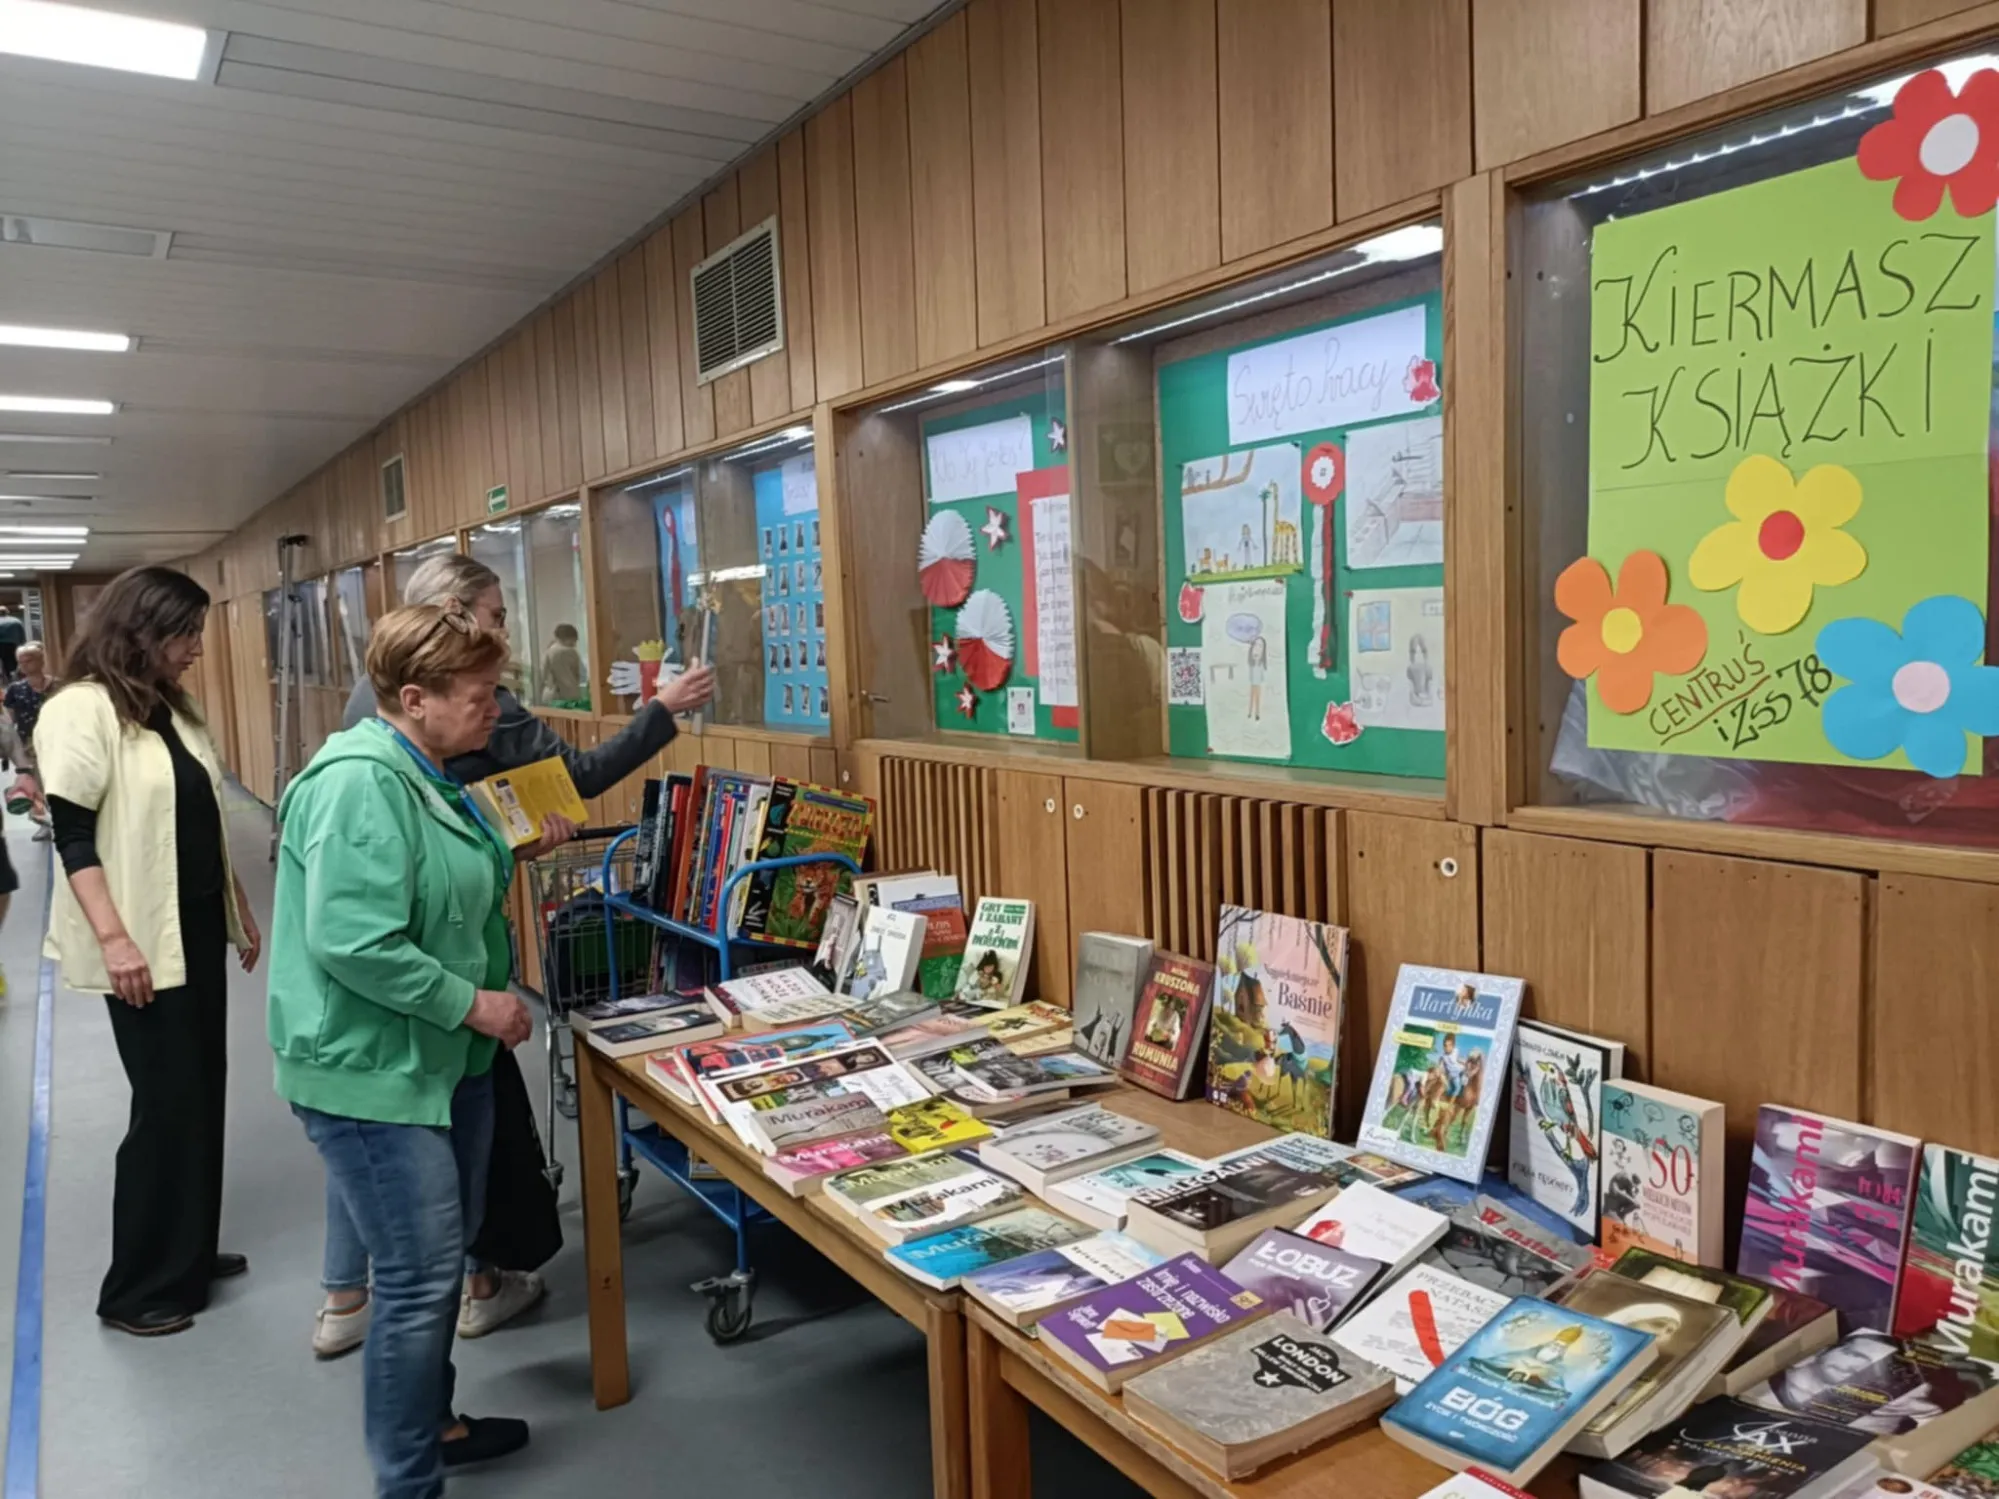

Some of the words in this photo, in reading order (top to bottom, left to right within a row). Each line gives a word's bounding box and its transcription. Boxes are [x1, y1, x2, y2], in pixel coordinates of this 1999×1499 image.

[1621, 328, 1936, 469] KSIĄŻKI
[1649, 629, 1766, 736] CENTRUŚ
[1775, 653, 1832, 708] 78
[1278, 981, 1333, 1020] Baśnie
[1414, 991, 1495, 1022] Martynka
[1132, 1041, 1179, 1072] RUMUNIA
[1135, 1155, 1271, 1205] NIELEGALNI
[1649, 1142, 1692, 1196] 50
[1255, 1239, 1362, 1290] ŁOBUZ
[1932, 1152, 1999, 1355] Murakami
[1271, 1336, 1347, 1384] LONDON
[1440, 1386, 1531, 1432] BÓG
